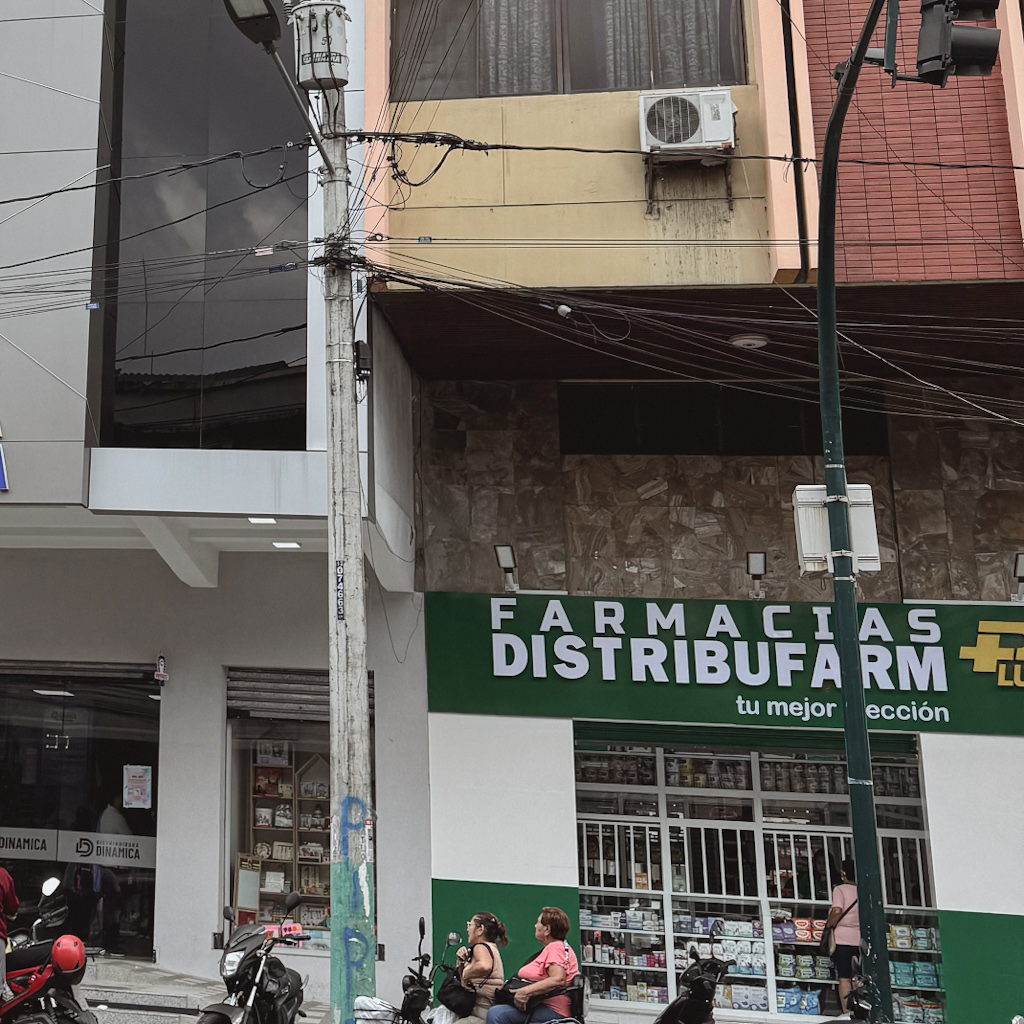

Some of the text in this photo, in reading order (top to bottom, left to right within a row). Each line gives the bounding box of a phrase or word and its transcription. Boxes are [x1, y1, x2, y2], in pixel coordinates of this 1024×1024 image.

[336, 566, 344, 615] 074663
[490, 597, 942, 644] FARMACIAS
[492, 633, 948, 692] DISTRIBUFARM
[736, 695, 950, 722] tu mejor ección
[96, 845, 140, 860] DINAMICA
